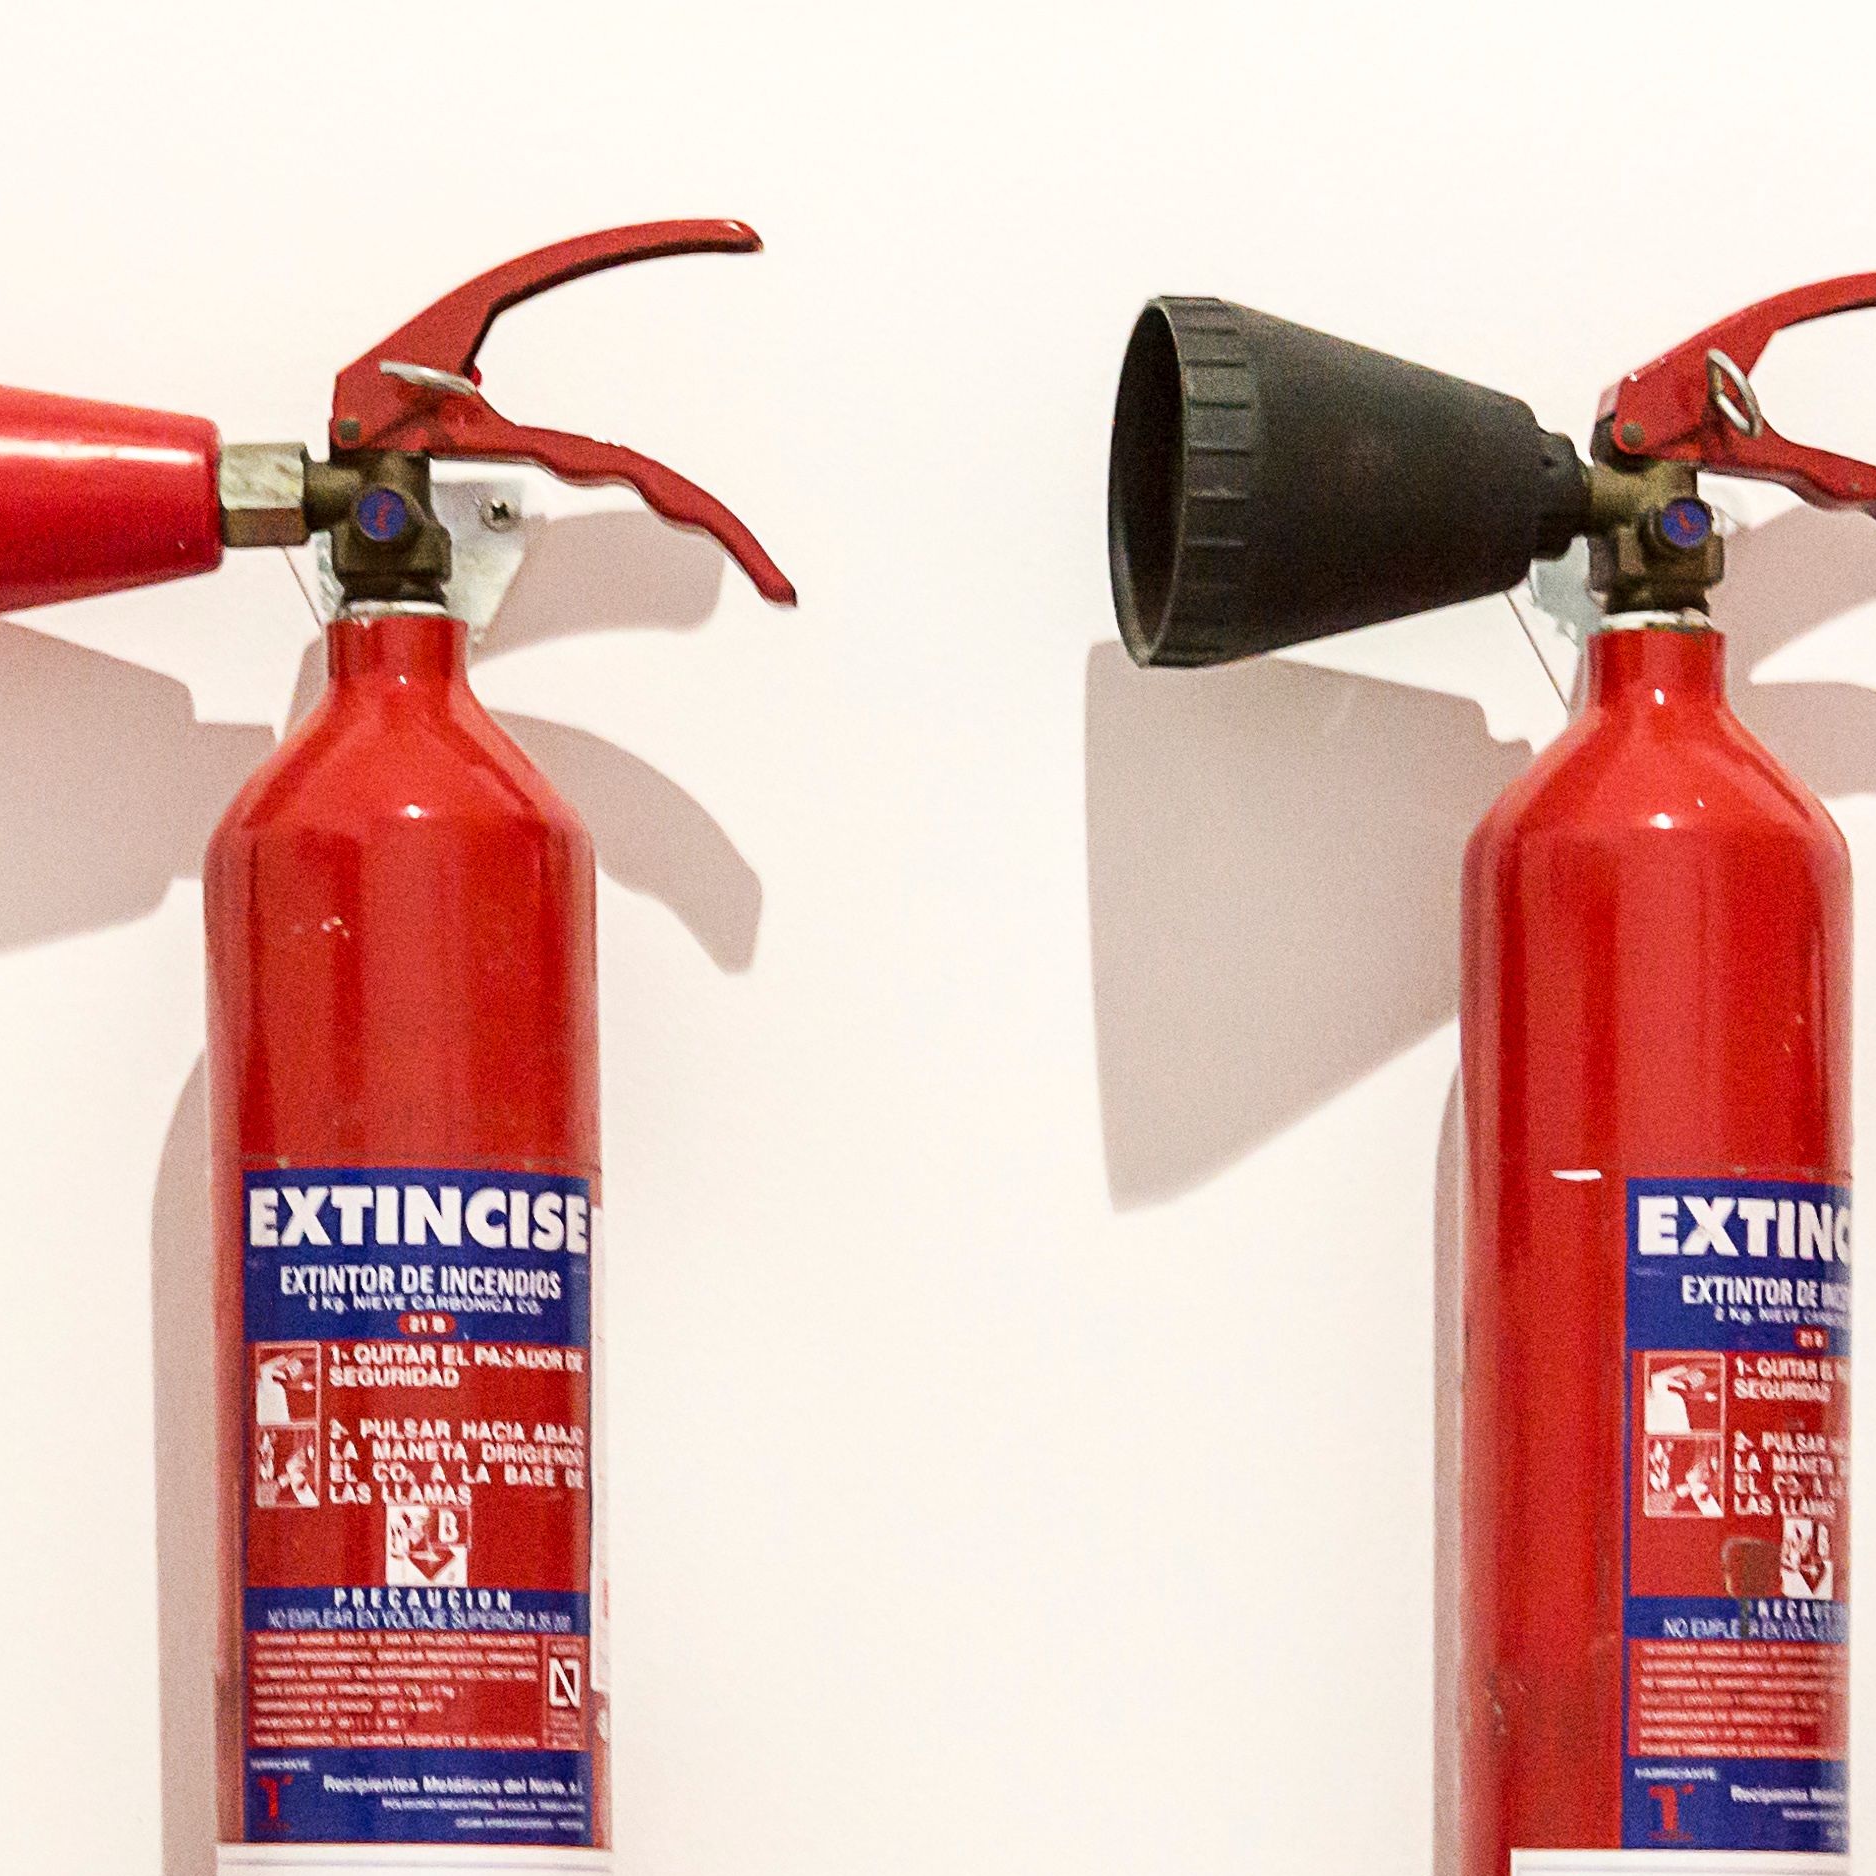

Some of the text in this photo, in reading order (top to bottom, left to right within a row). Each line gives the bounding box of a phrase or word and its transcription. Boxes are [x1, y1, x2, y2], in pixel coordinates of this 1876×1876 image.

[248, 1182, 591, 1256] EXTINCISE
[280, 1264, 562, 1300] EXTINTOR DE INCENDIOS
[1681, 1274, 1793, 1306] EXTINTOR
[353, 1346, 437, 1368] QUITAR
[441, 1348, 471, 1367] EL
[328, 1365, 460, 1389] SEGURIDAD
[360, 1420, 525, 1442] PULSAR HACIA
[328, 1441, 470, 1462] LA MANETA
[328, 1463, 359, 1483] EL
[430, 1463, 447, 1483] A
[462, 1463, 493, 1484] LA
[328, 1484, 472, 1505] LAS LLAMAS
[1733, 1494, 1773, 1516] LAS
[333, 1588, 513, 1611] PRECAUCION
